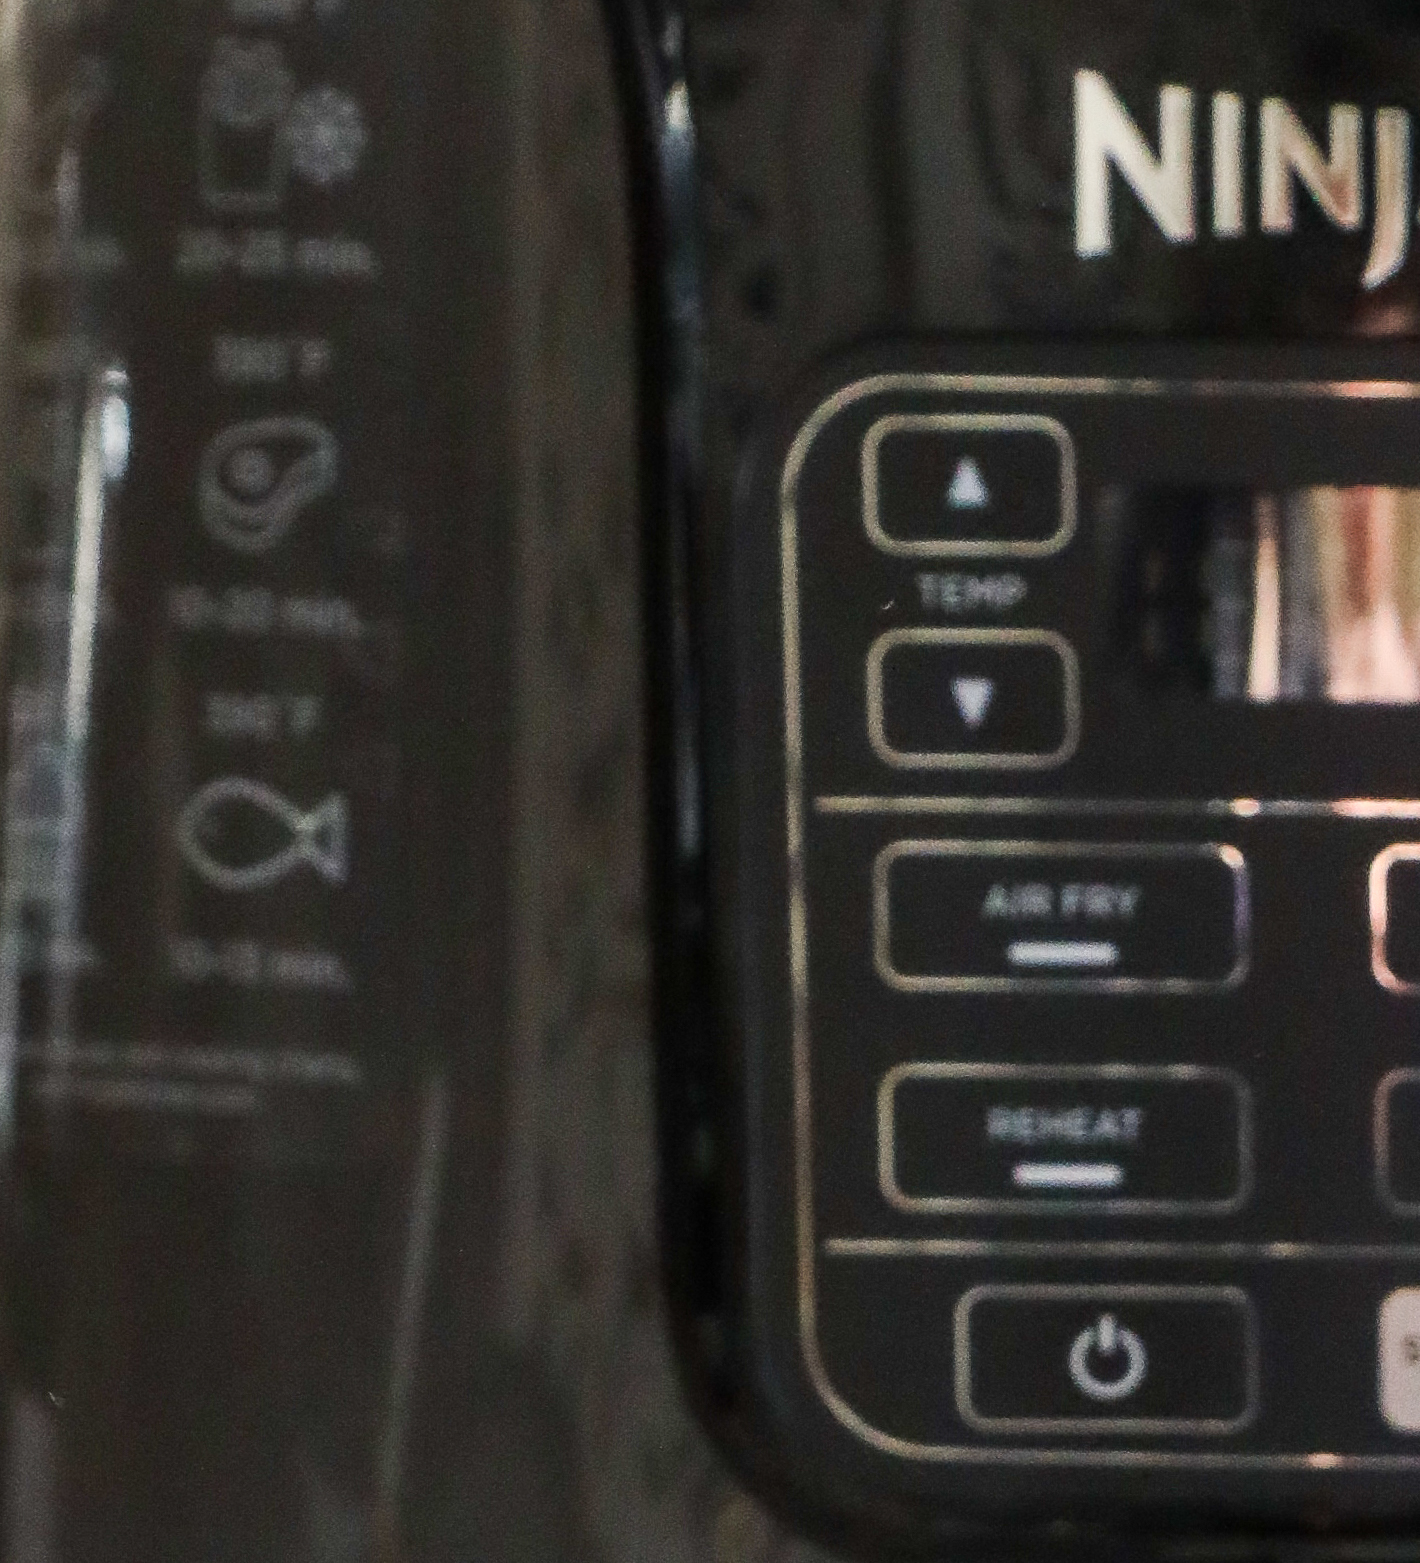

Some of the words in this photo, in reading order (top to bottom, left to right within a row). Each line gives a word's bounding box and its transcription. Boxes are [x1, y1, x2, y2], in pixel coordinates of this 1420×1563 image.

[917, 572, 1026, 613] TEMP
[982, 880, 1055, 920] AIR
[1061, 881, 1140, 920] FRY
[984, 1104, 1142, 1145] REHEAT
